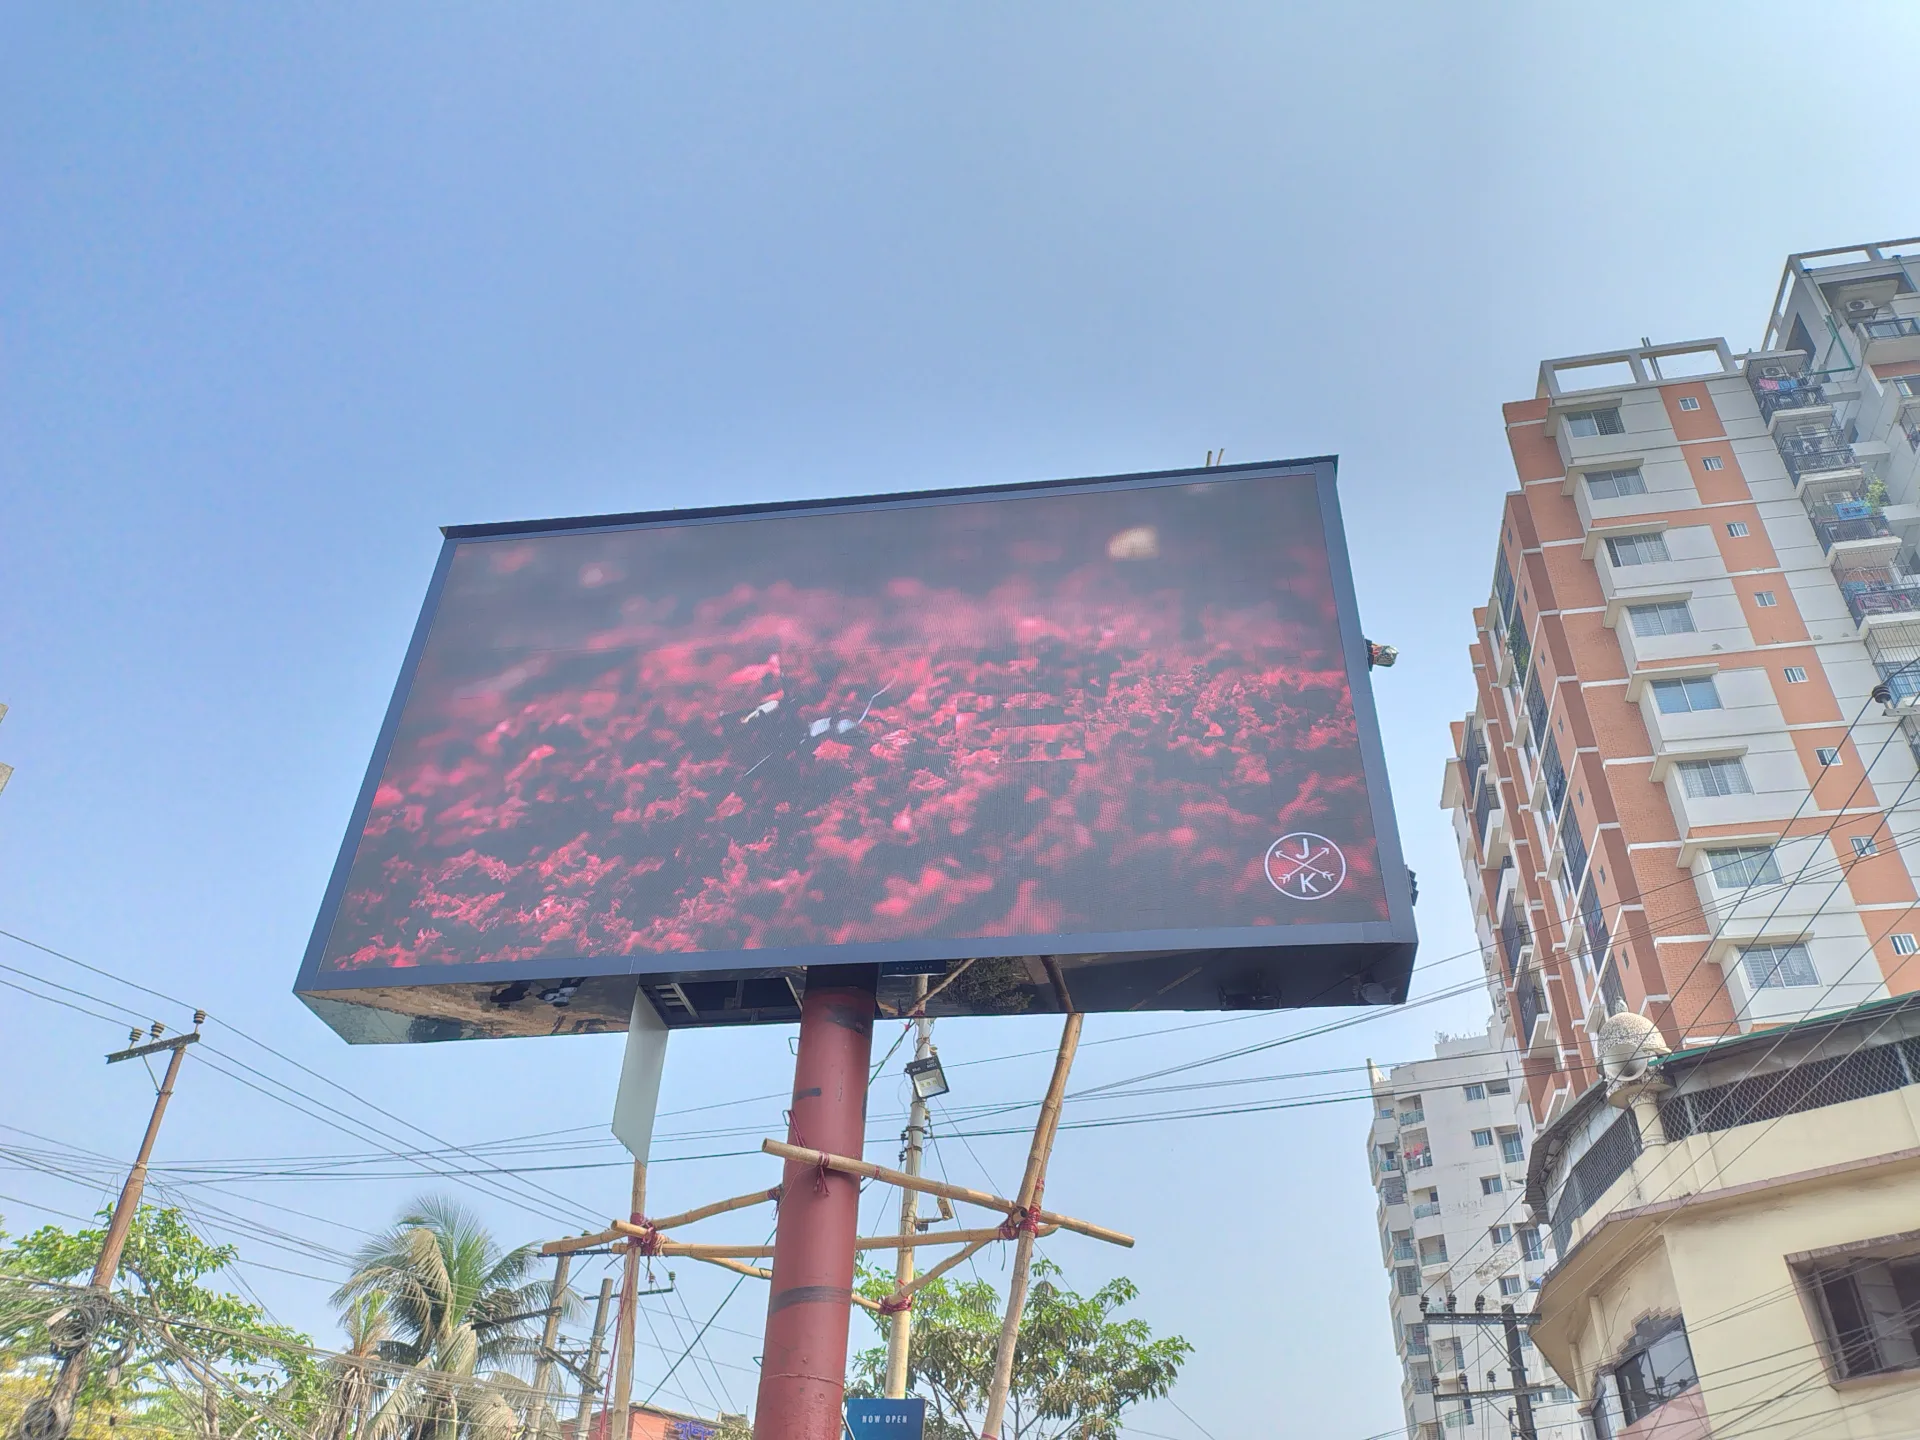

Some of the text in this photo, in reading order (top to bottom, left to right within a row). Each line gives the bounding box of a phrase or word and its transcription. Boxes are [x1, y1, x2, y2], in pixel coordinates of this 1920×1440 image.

[1295, 838, 1310, 860] J
[1299, 872, 1320, 893] K
[862, 1415, 907, 1424] NOW OPEN
